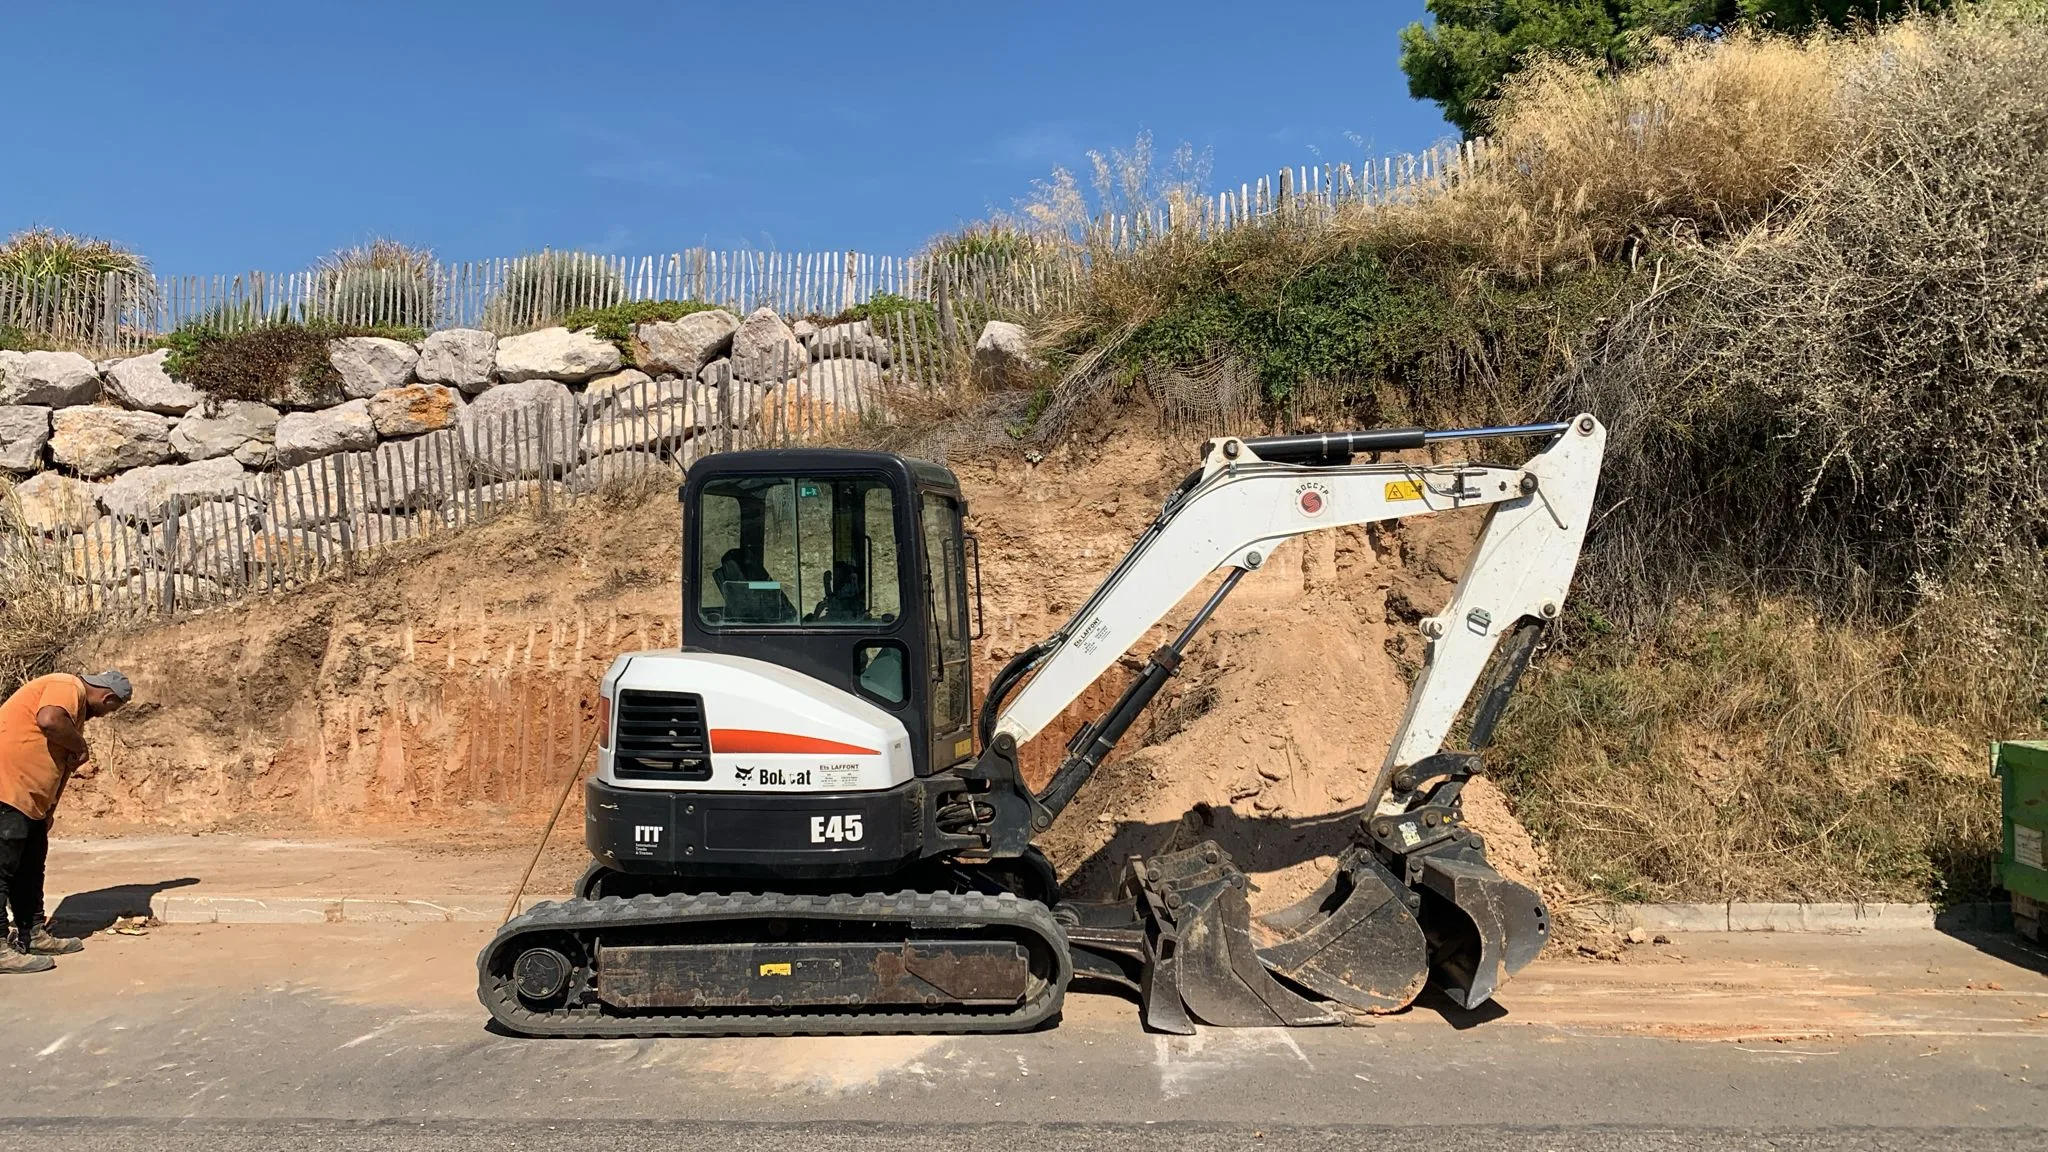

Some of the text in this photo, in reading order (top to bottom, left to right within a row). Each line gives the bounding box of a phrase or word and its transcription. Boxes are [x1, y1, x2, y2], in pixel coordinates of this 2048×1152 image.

[1081, 617, 1100, 638] LAFFONT
[831, 763, 860, 771] LAFFONT
[810, 814, 863, 843] E45
